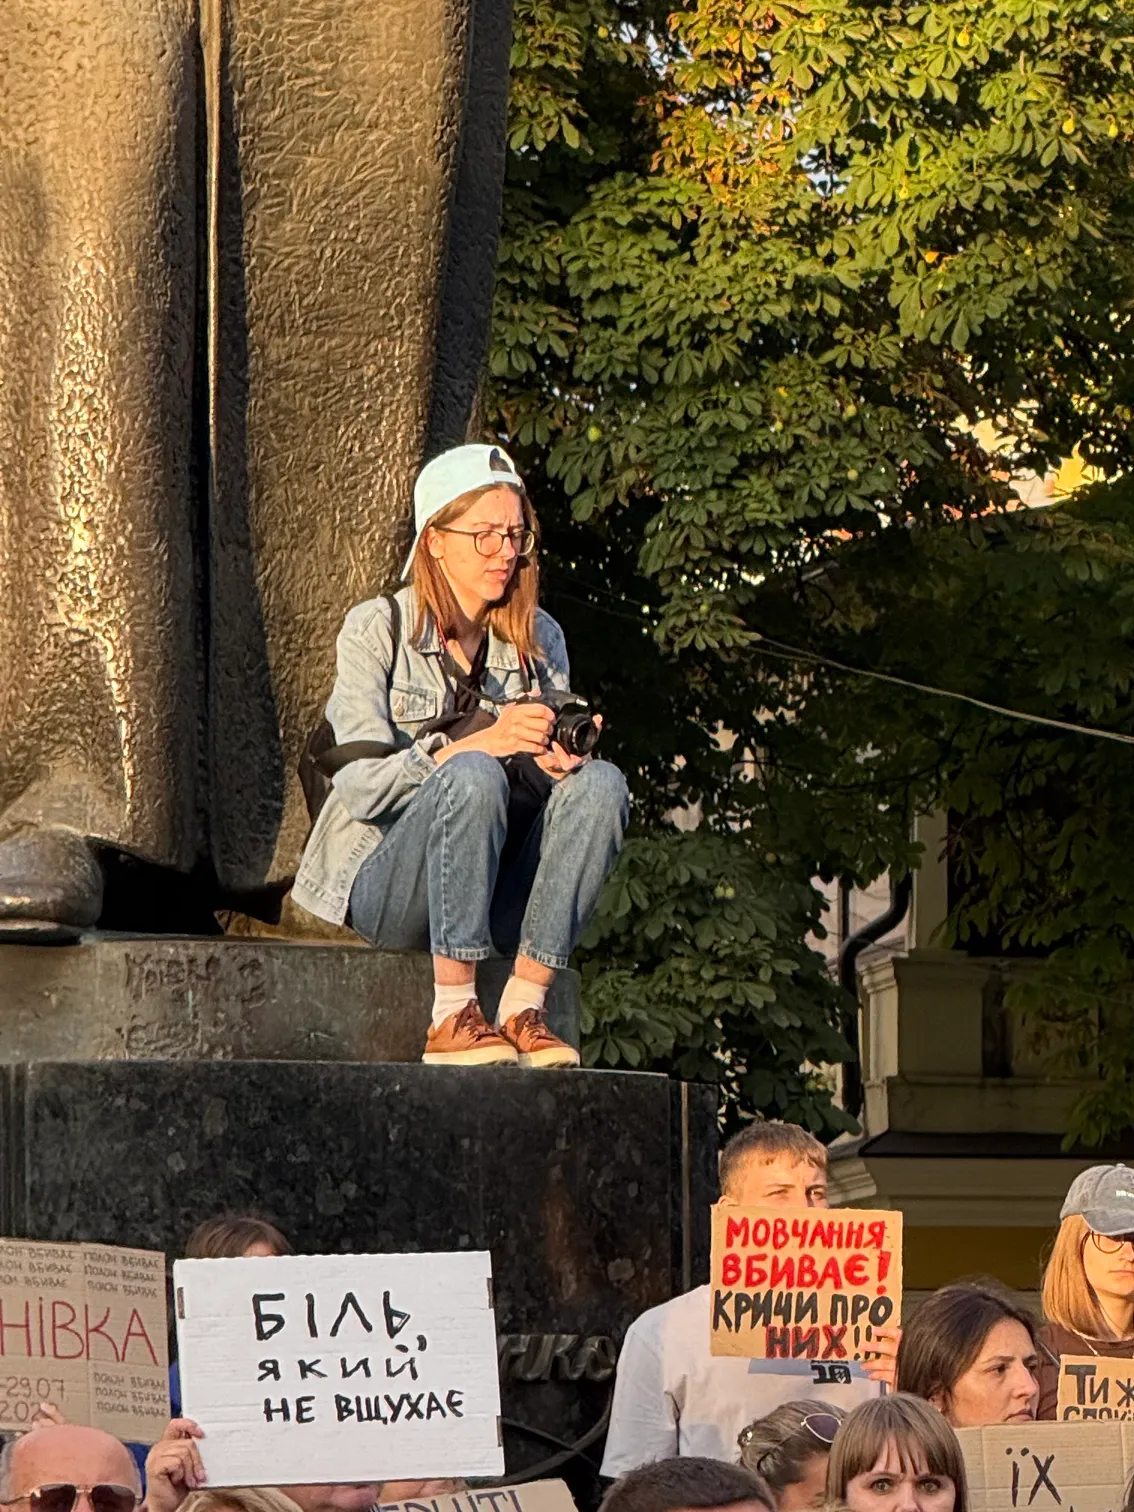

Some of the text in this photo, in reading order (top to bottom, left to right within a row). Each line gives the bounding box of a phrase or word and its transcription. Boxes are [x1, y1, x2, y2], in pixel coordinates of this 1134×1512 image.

[726, 1215, 885, 1250] МОВЧАННЯ
[721, 1250, 892, 1295] ВБИВАЄ!
[0, 1296, 159, 1366] НІВКА
[252, 1291, 427, 1352] БІЛЬ,
[713, 1289, 894, 1333] КРИЧИ ПРО
[264, 1389, 464, 1425] НЕ ВЩУХАЄ
[1006, 1447, 1062, 1507] ЇХ
